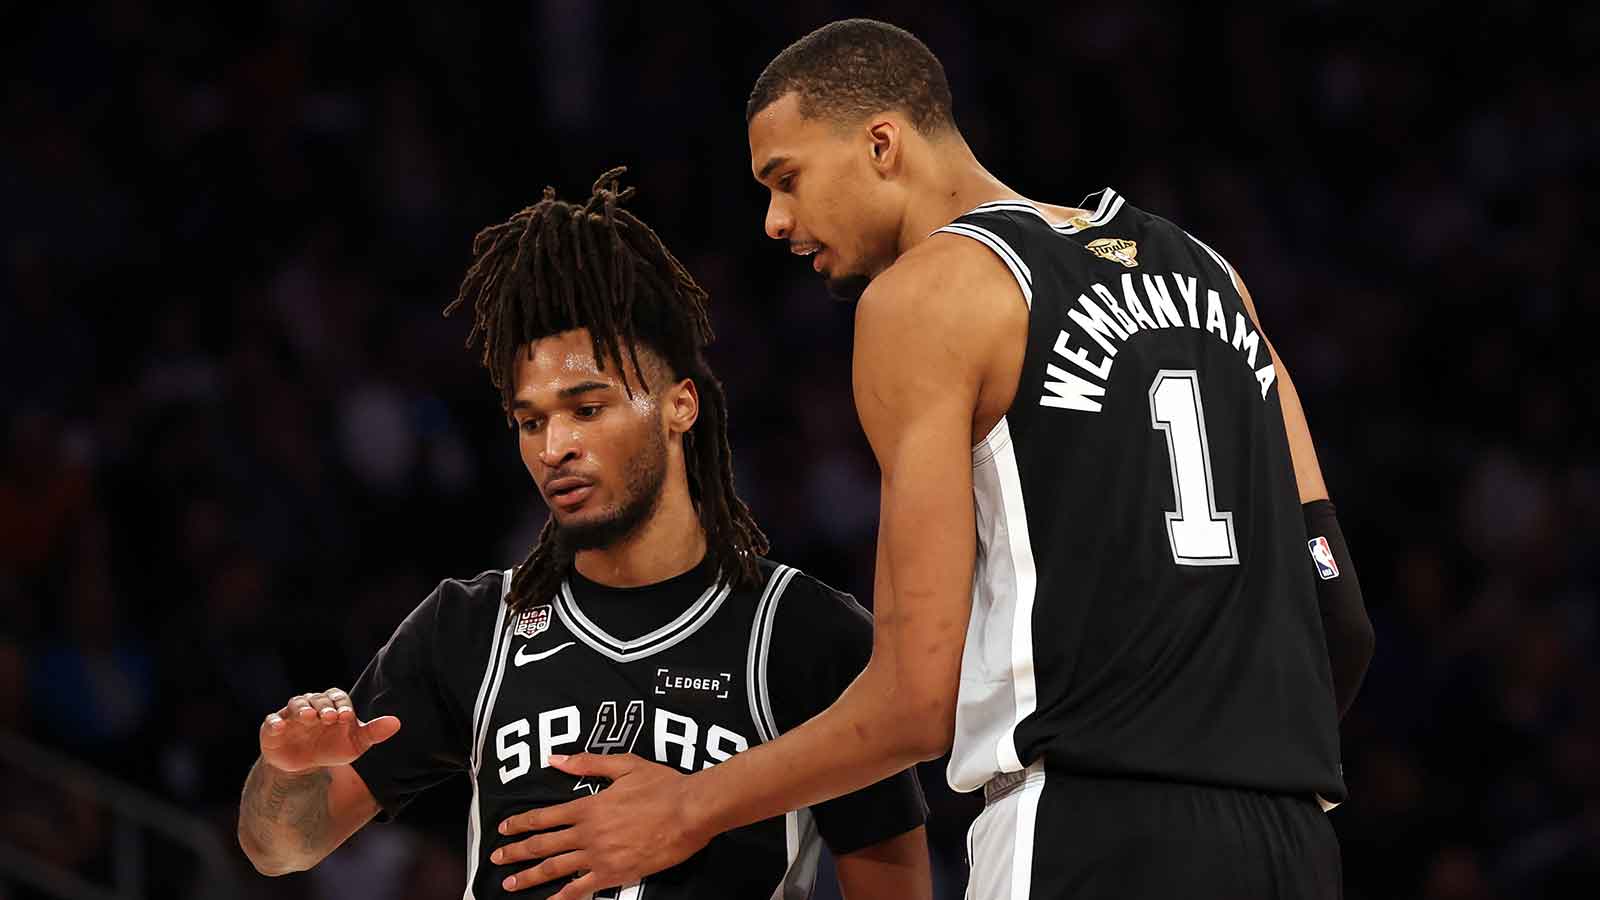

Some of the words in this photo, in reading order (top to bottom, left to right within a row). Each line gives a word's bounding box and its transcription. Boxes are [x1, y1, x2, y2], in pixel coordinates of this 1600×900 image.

[1039, 273, 1276, 412] WEMBANYAMA
[1148, 369, 1240, 565] 1
[522, 610, 547, 619] USA
[518, 621, 547, 632] 250
[665, 676, 720, 691] LEDGER
